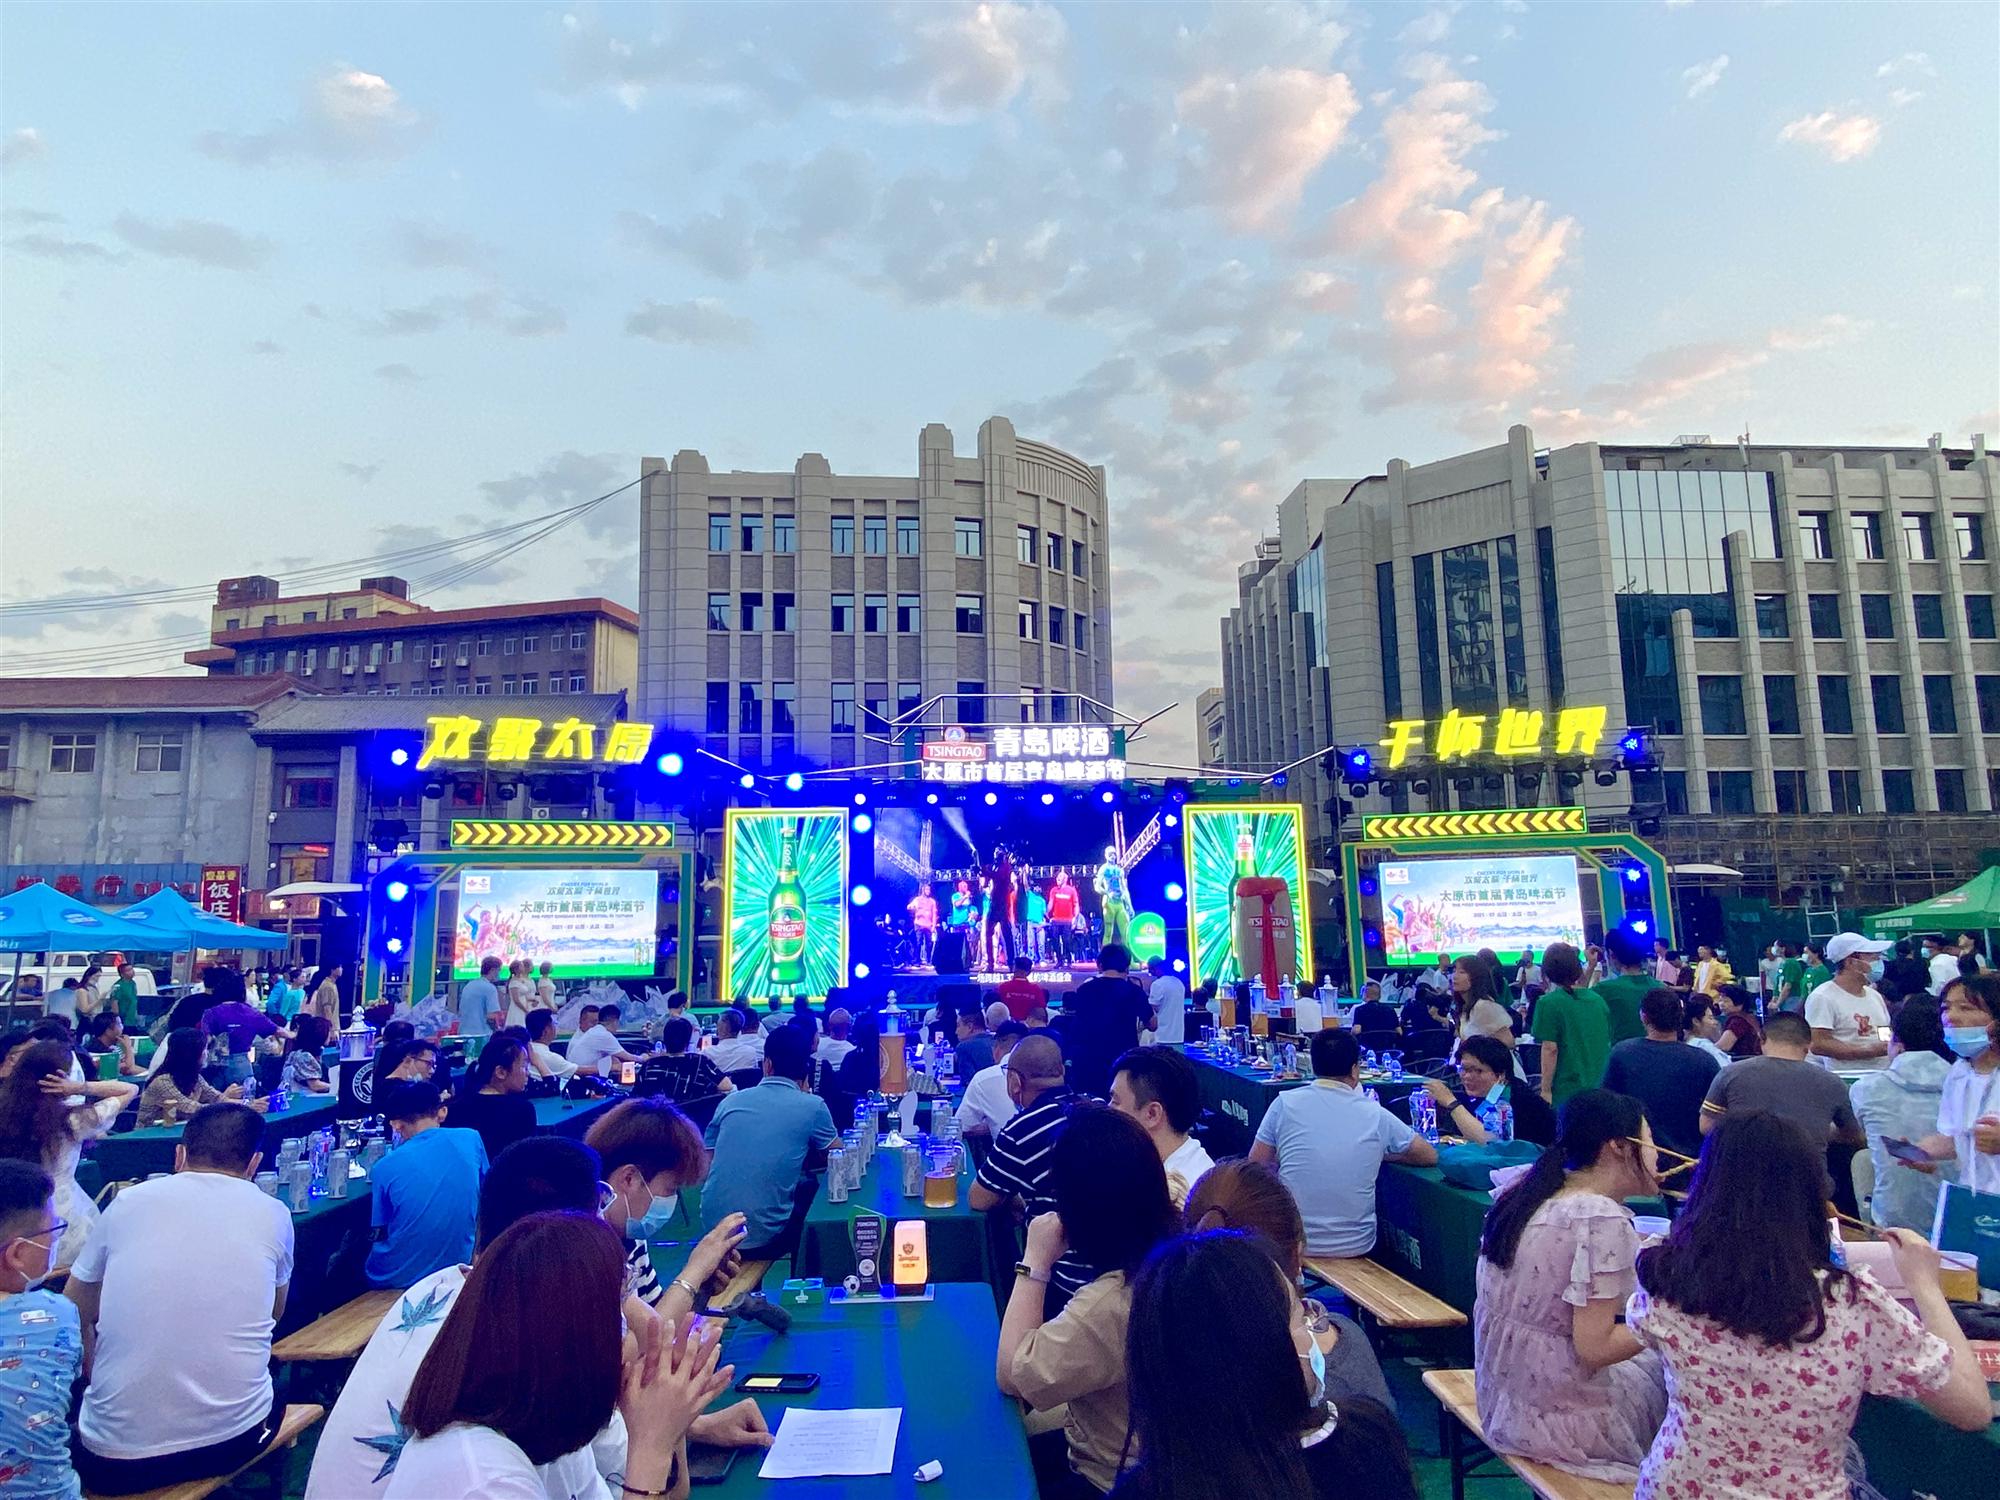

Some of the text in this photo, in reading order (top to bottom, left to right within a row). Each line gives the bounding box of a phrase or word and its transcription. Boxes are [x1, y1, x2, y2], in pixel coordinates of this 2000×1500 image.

[416, 715, 654, 769] 欢聚太原
[1379, 706, 1607, 769] 干杯世界
[927, 744, 983, 758] TSINGTAO
[207, 882, 233, 916] 饭庄
[1440, 887, 1566, 902] 太原市首届青岛啤酒节
[520, 900, 645, 913] 太原市首届青岛啤酒节
[771, 923, 804, 932] TSINGTAO
